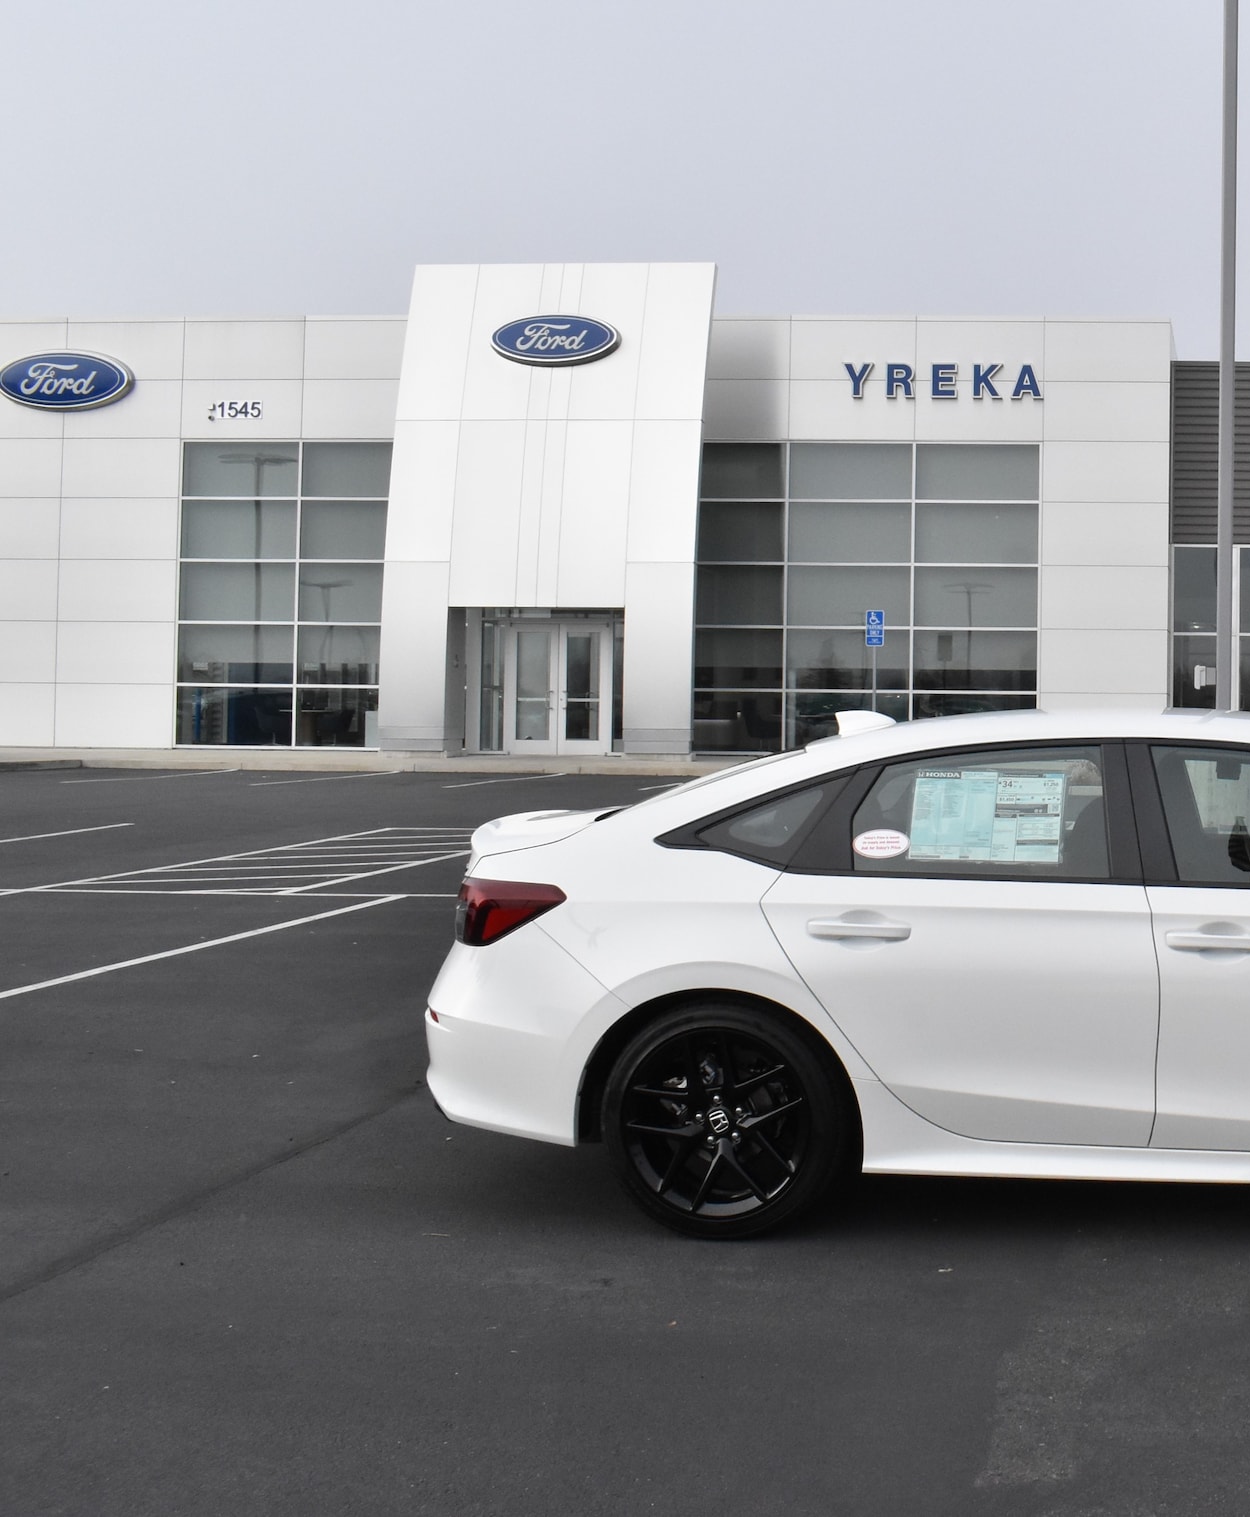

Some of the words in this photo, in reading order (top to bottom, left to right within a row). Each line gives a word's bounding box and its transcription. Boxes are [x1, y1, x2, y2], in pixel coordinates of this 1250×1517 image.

[514, 322, 589, 351] Ford
[20, 362, 97, 395] Ford
[844, 362, 1044, 400] YREKA
[217, 401, 262, 418] 1545
